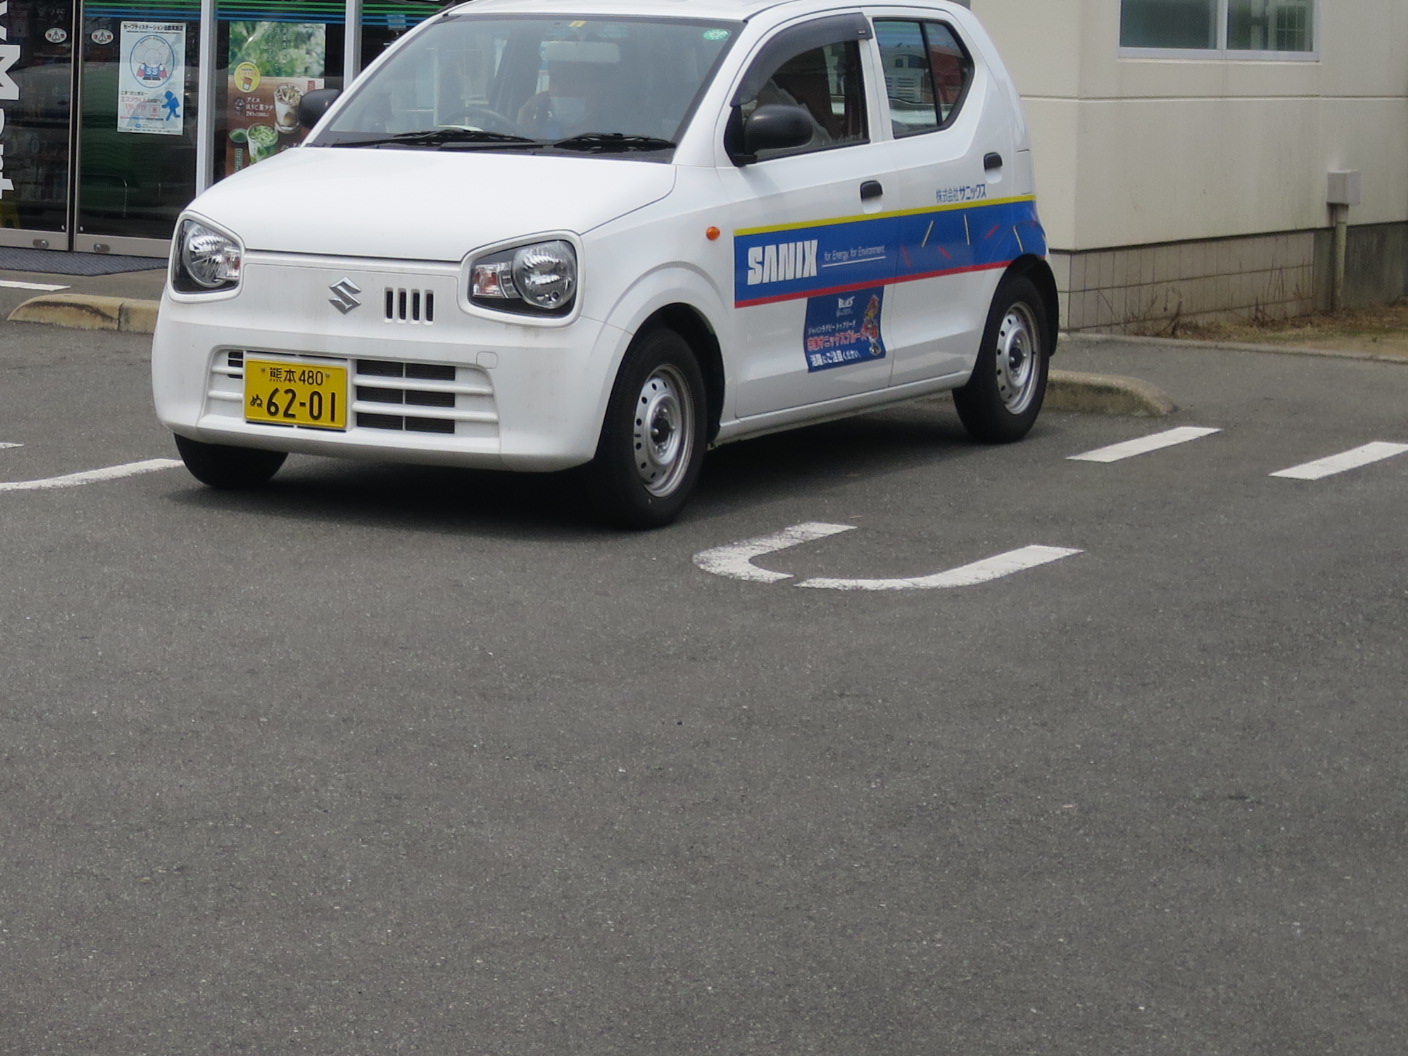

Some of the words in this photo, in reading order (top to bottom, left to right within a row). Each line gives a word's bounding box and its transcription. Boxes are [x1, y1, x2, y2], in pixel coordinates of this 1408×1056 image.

[747, 239, 818, 285] SANIX
[250, 394, 263, 408] ぬ
[266, 387, 336, 422] 62-01
